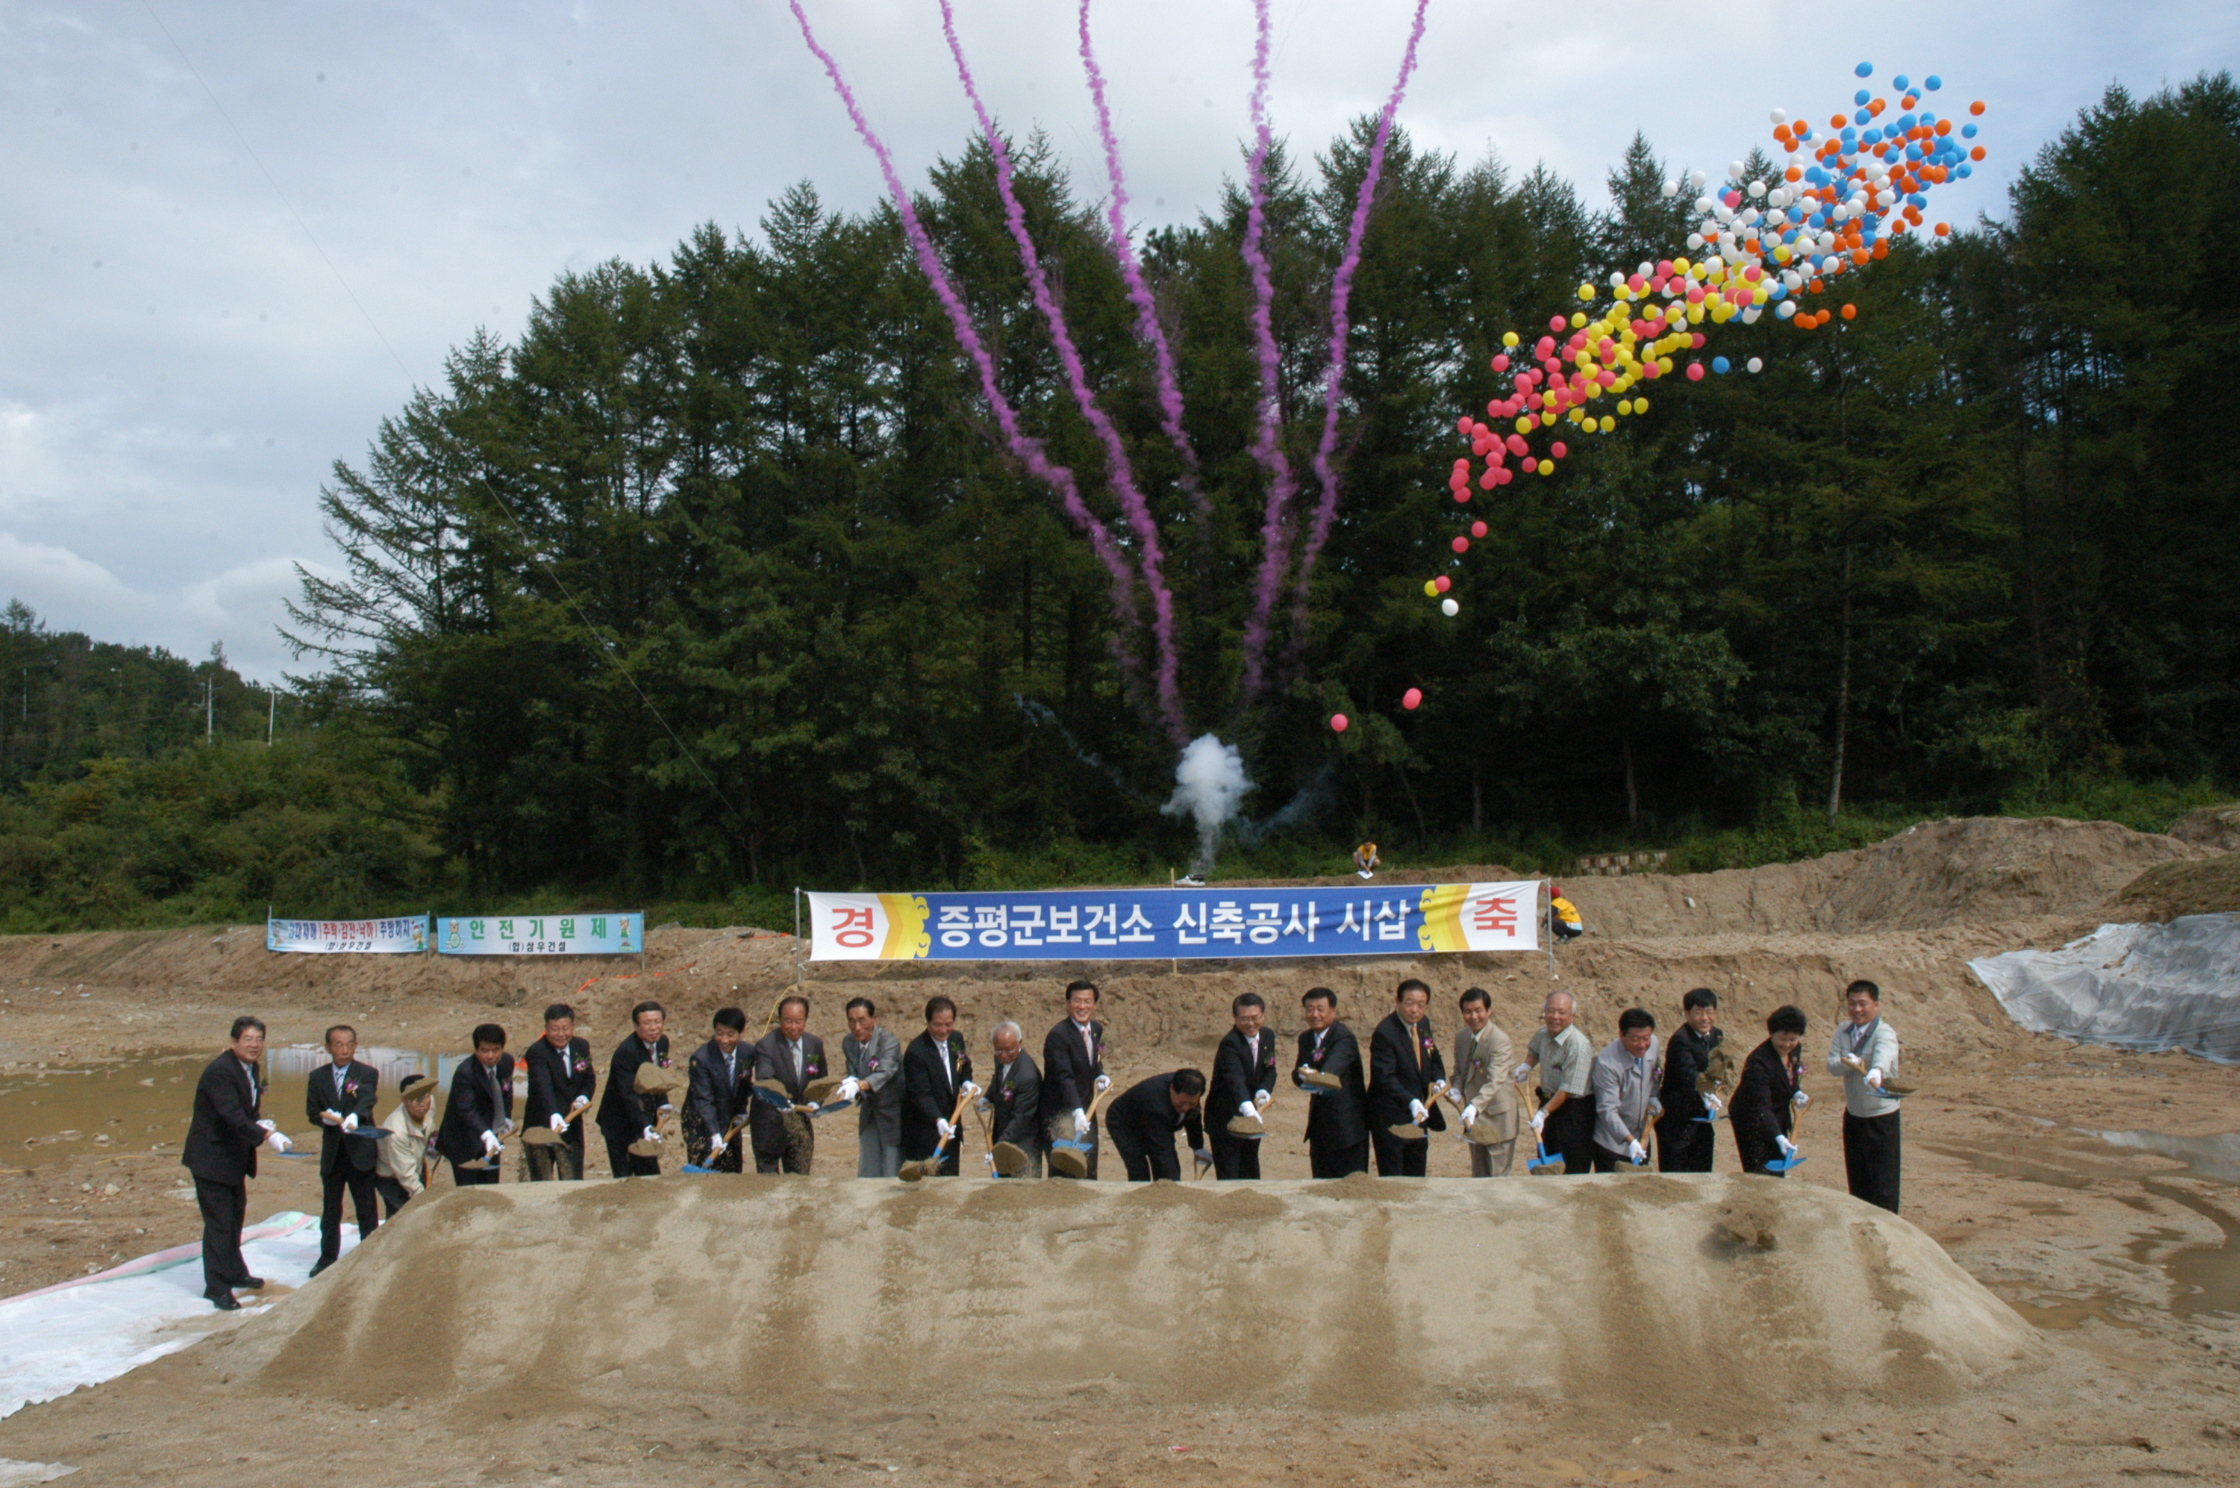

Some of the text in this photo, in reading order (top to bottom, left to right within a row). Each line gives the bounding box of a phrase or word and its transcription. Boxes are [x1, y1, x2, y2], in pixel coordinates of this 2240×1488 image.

[831, 897, 1517, 949] 경 증평군보건소 신축공사 시삽 축
